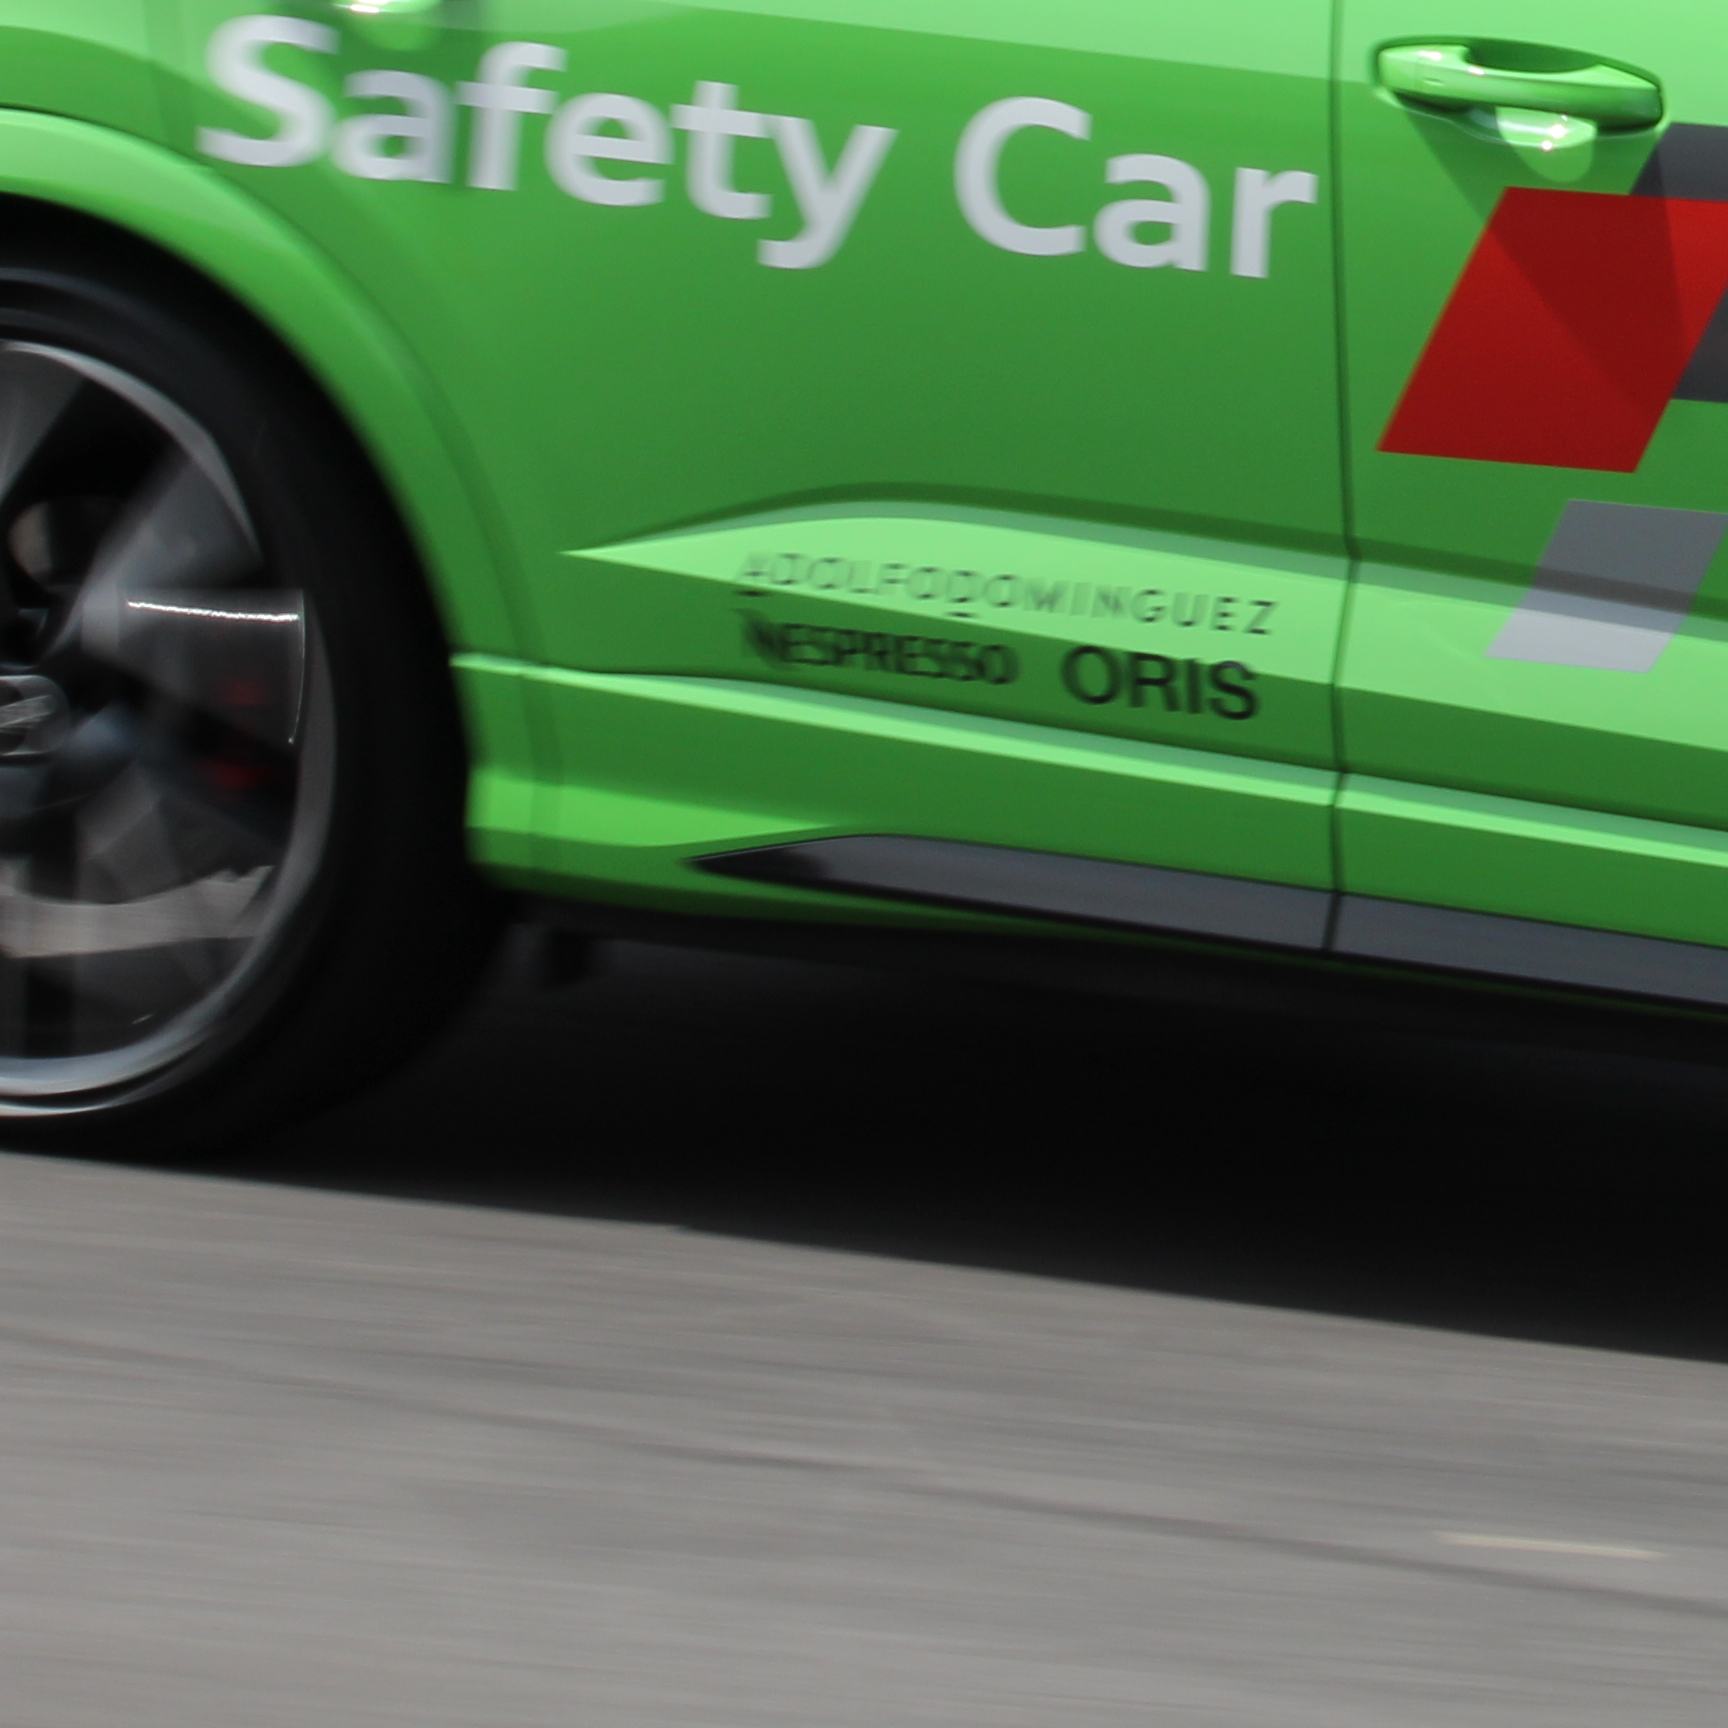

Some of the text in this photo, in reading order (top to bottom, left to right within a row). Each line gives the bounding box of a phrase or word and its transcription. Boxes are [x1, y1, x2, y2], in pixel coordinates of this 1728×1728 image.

[197, 13, 1320, 280] Safety Car
[742, 608, 1264, 722] NESPRESSO ORIS
